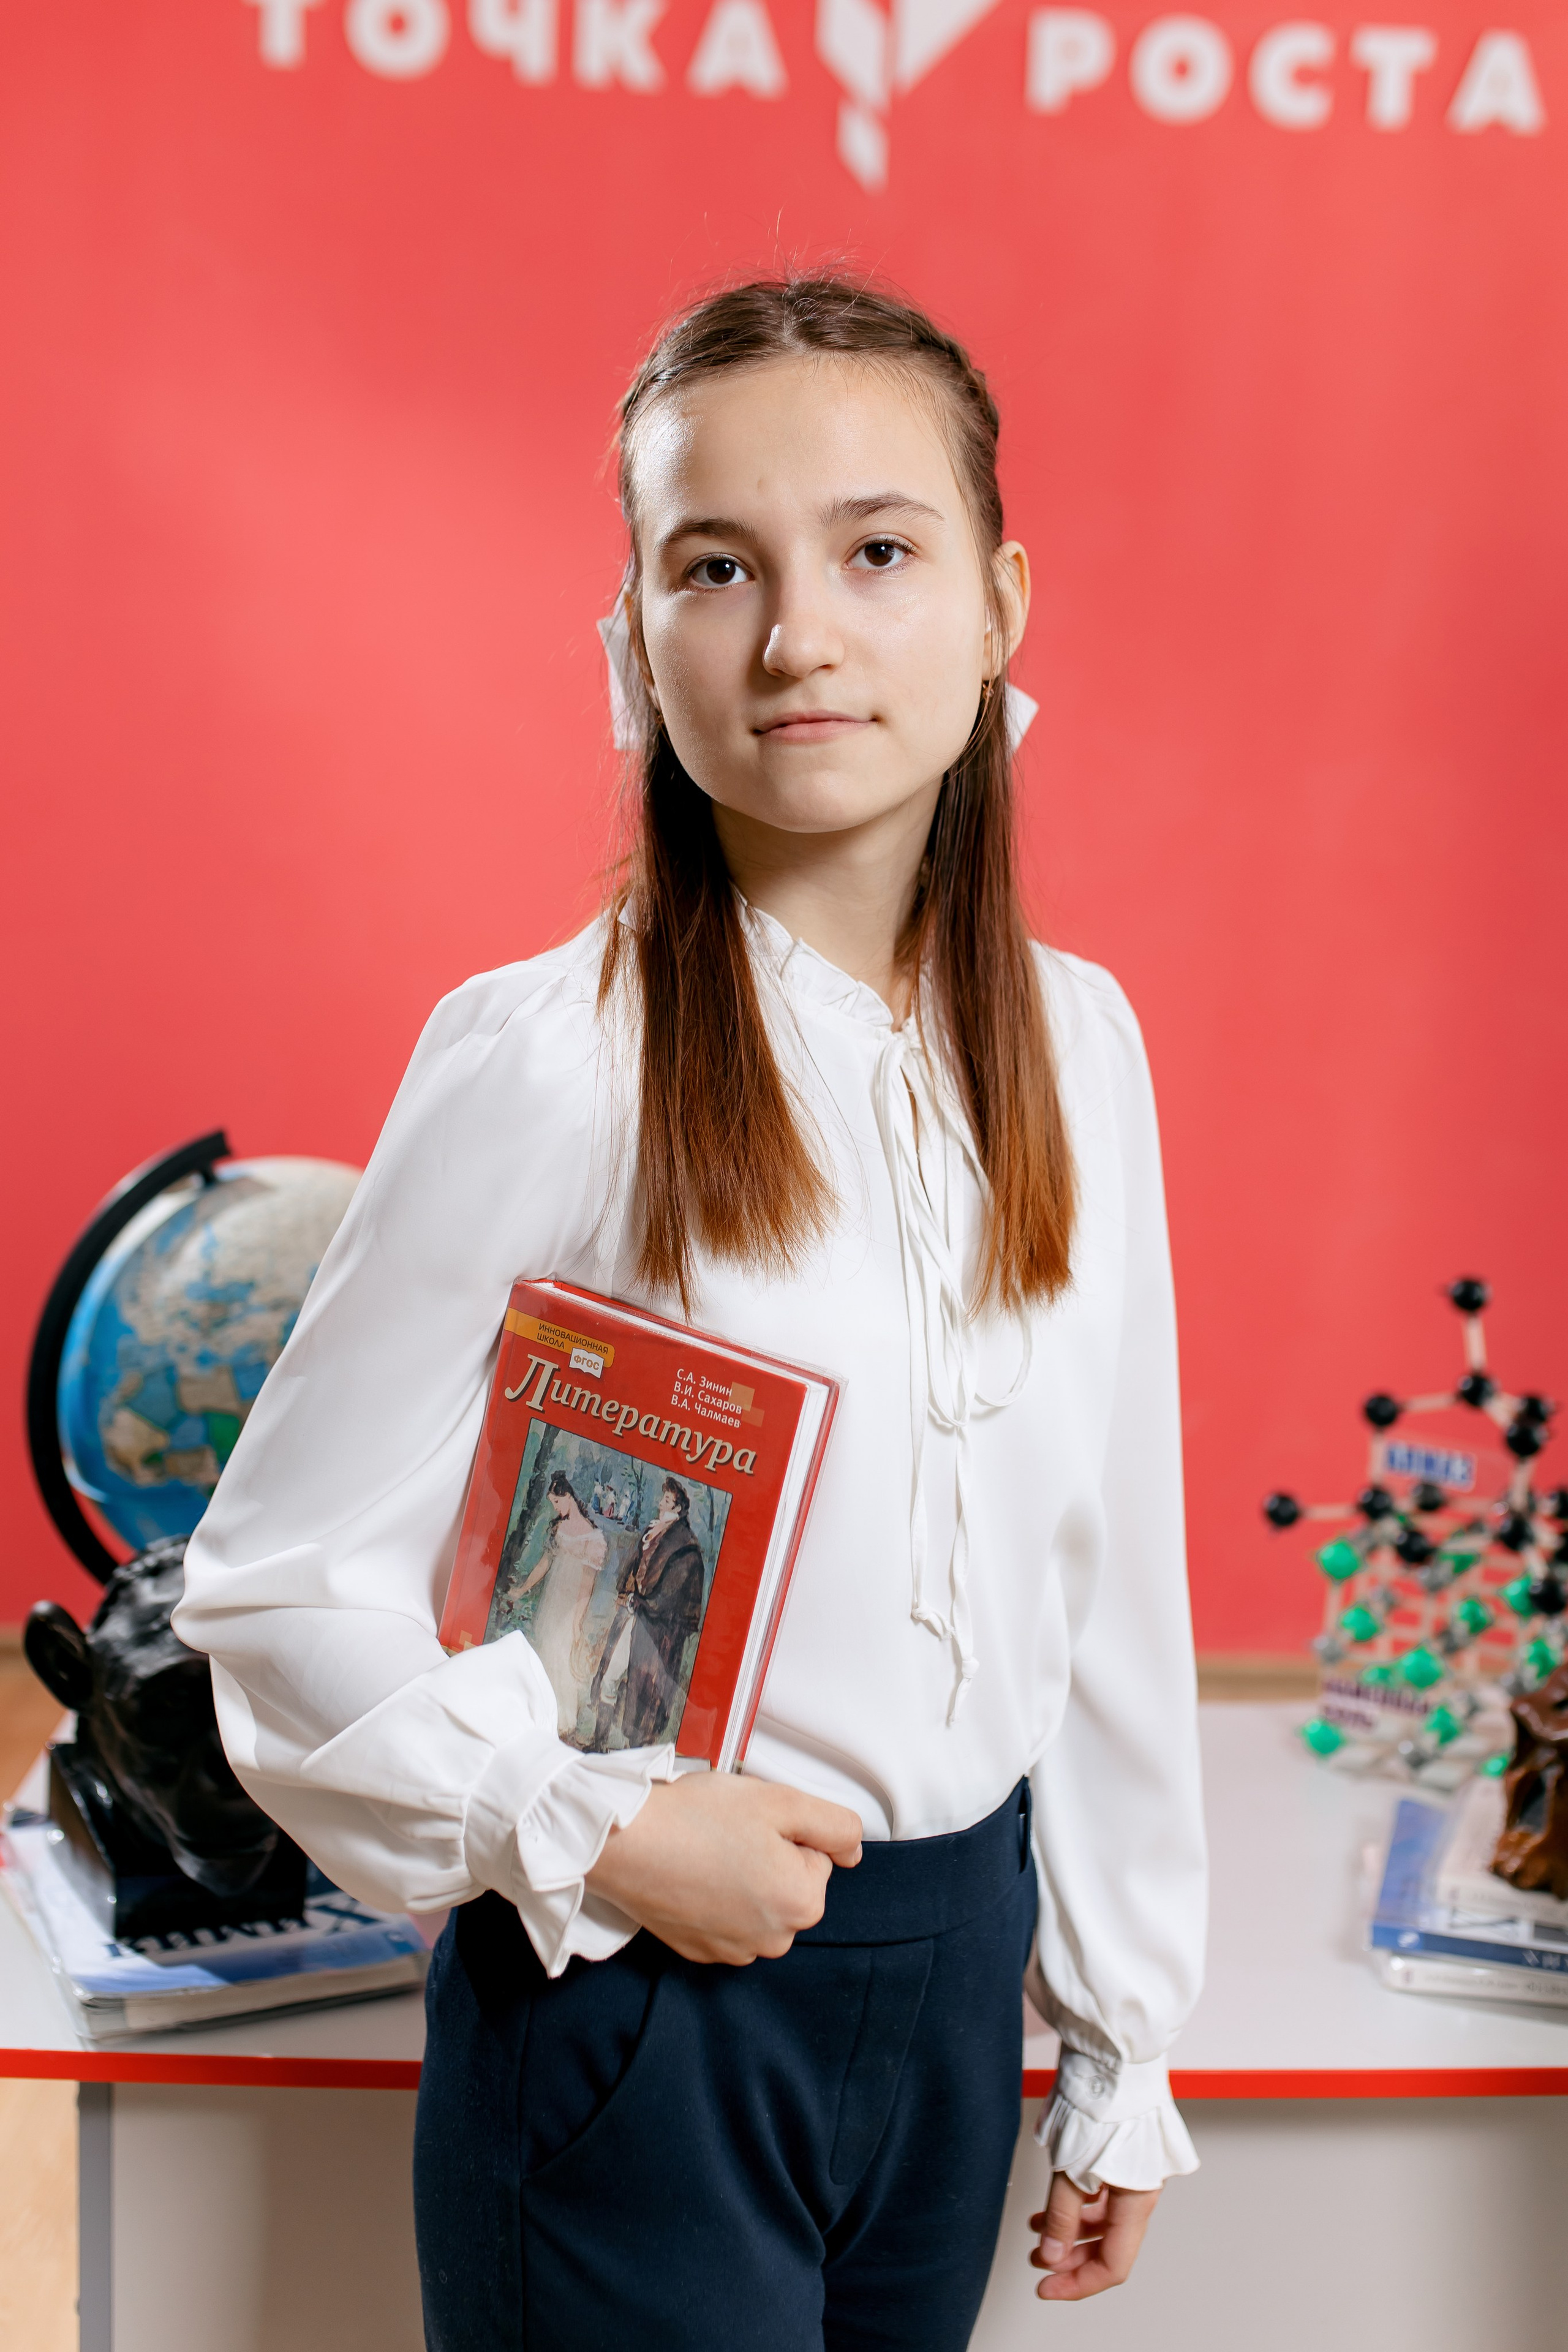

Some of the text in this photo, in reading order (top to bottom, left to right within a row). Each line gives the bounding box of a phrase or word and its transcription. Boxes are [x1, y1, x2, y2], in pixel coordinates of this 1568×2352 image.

[1024, 7, 1547, 136] РОСТА
[537, 1332, 565, 1349] ШКОЛА
[538, 1323, 609, 1355] ИННОВАЦИОННАЯ
[573, 1354, 600, 1370] ФГОС
[674, 1381, 742, 1414] В.И. Сахаров
[677, 1368, 733, 1397] С.А. Зинин
[505, 1353, 756, 1474] Литература
[671, 1394, 741, 1428] В.А. Чалмаев
